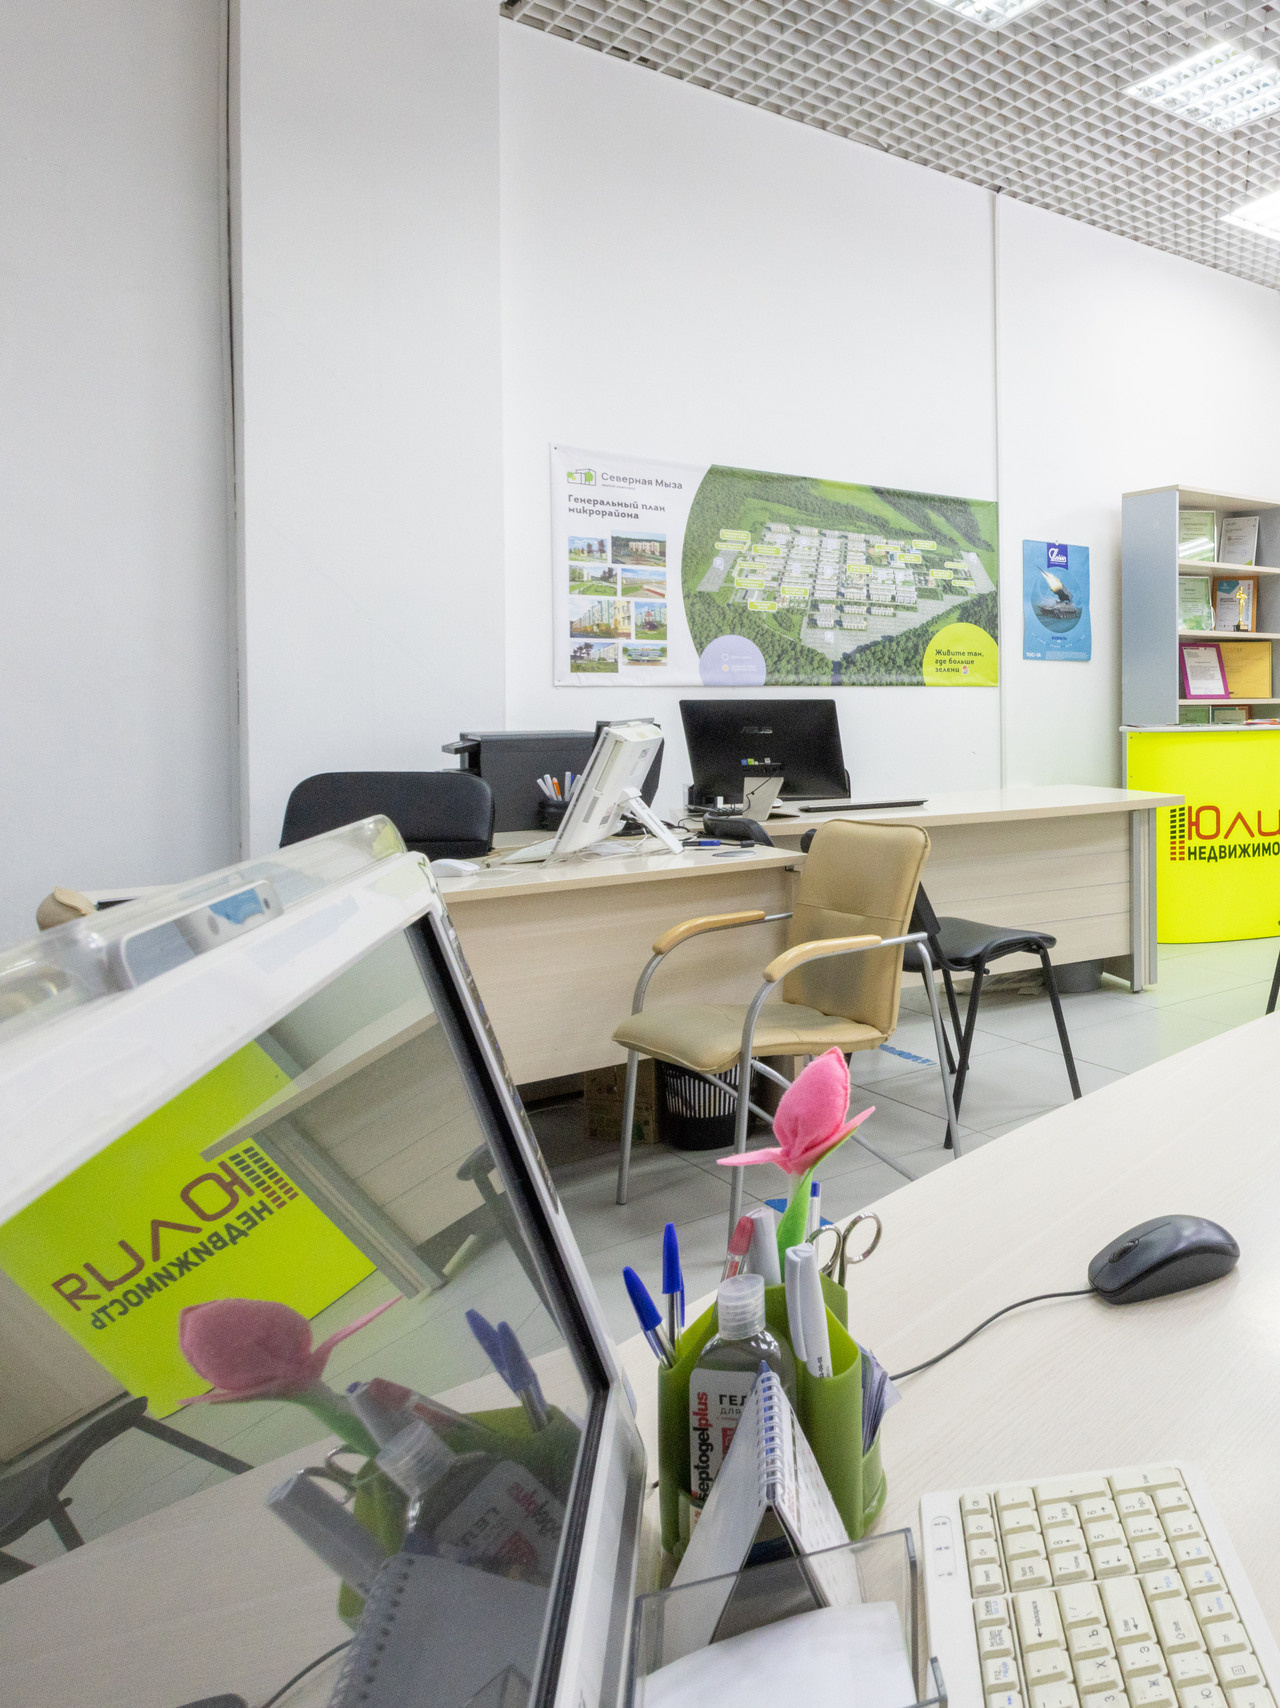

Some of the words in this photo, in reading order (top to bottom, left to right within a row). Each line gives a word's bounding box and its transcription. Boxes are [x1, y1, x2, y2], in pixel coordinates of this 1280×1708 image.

[601, 472, 653, 487] Северная
[655, 479, 683, 490] Мыза
[568, 494, 639, 509] Генеральный
[641, 503, 666, 512] план
[568, 506, 639, 519] микрорайона
[935, 649, 966, 657] Живите
[1031, 1601, 1041, 1627] Backspace
